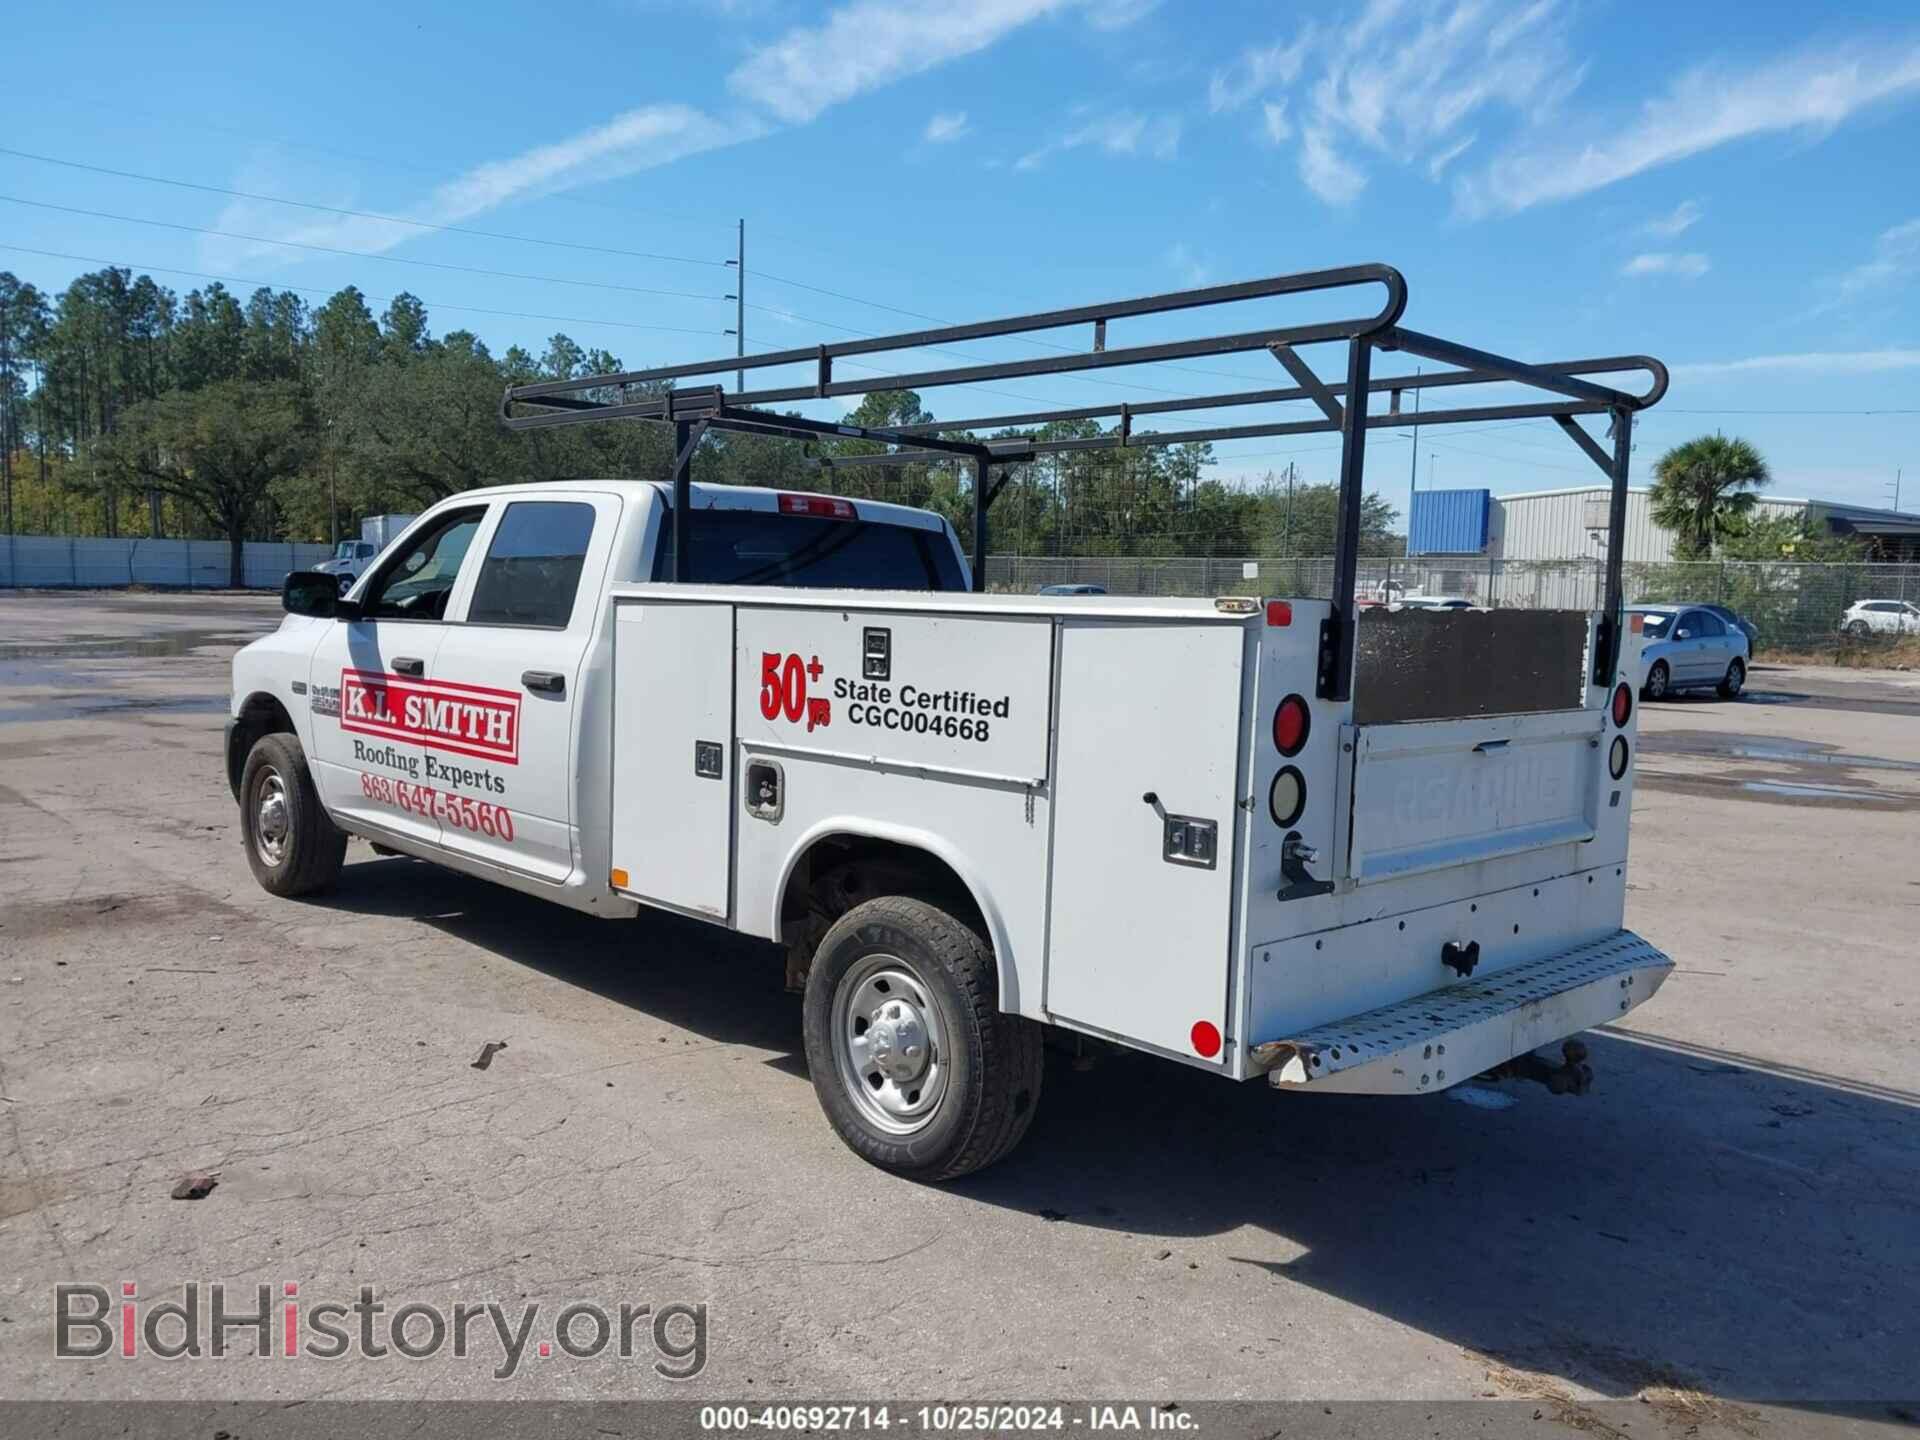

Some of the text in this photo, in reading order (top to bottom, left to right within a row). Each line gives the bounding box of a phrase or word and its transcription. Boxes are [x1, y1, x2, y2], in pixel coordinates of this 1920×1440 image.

[347, 686, 397, 724] K.L.
[404, 695, 512, 745] SMITH
[834, 677, 1010, 718] State Certified
[848, 703, 990, 742] CGC004668
[353, 739, 505, 794] Roofing Experts
